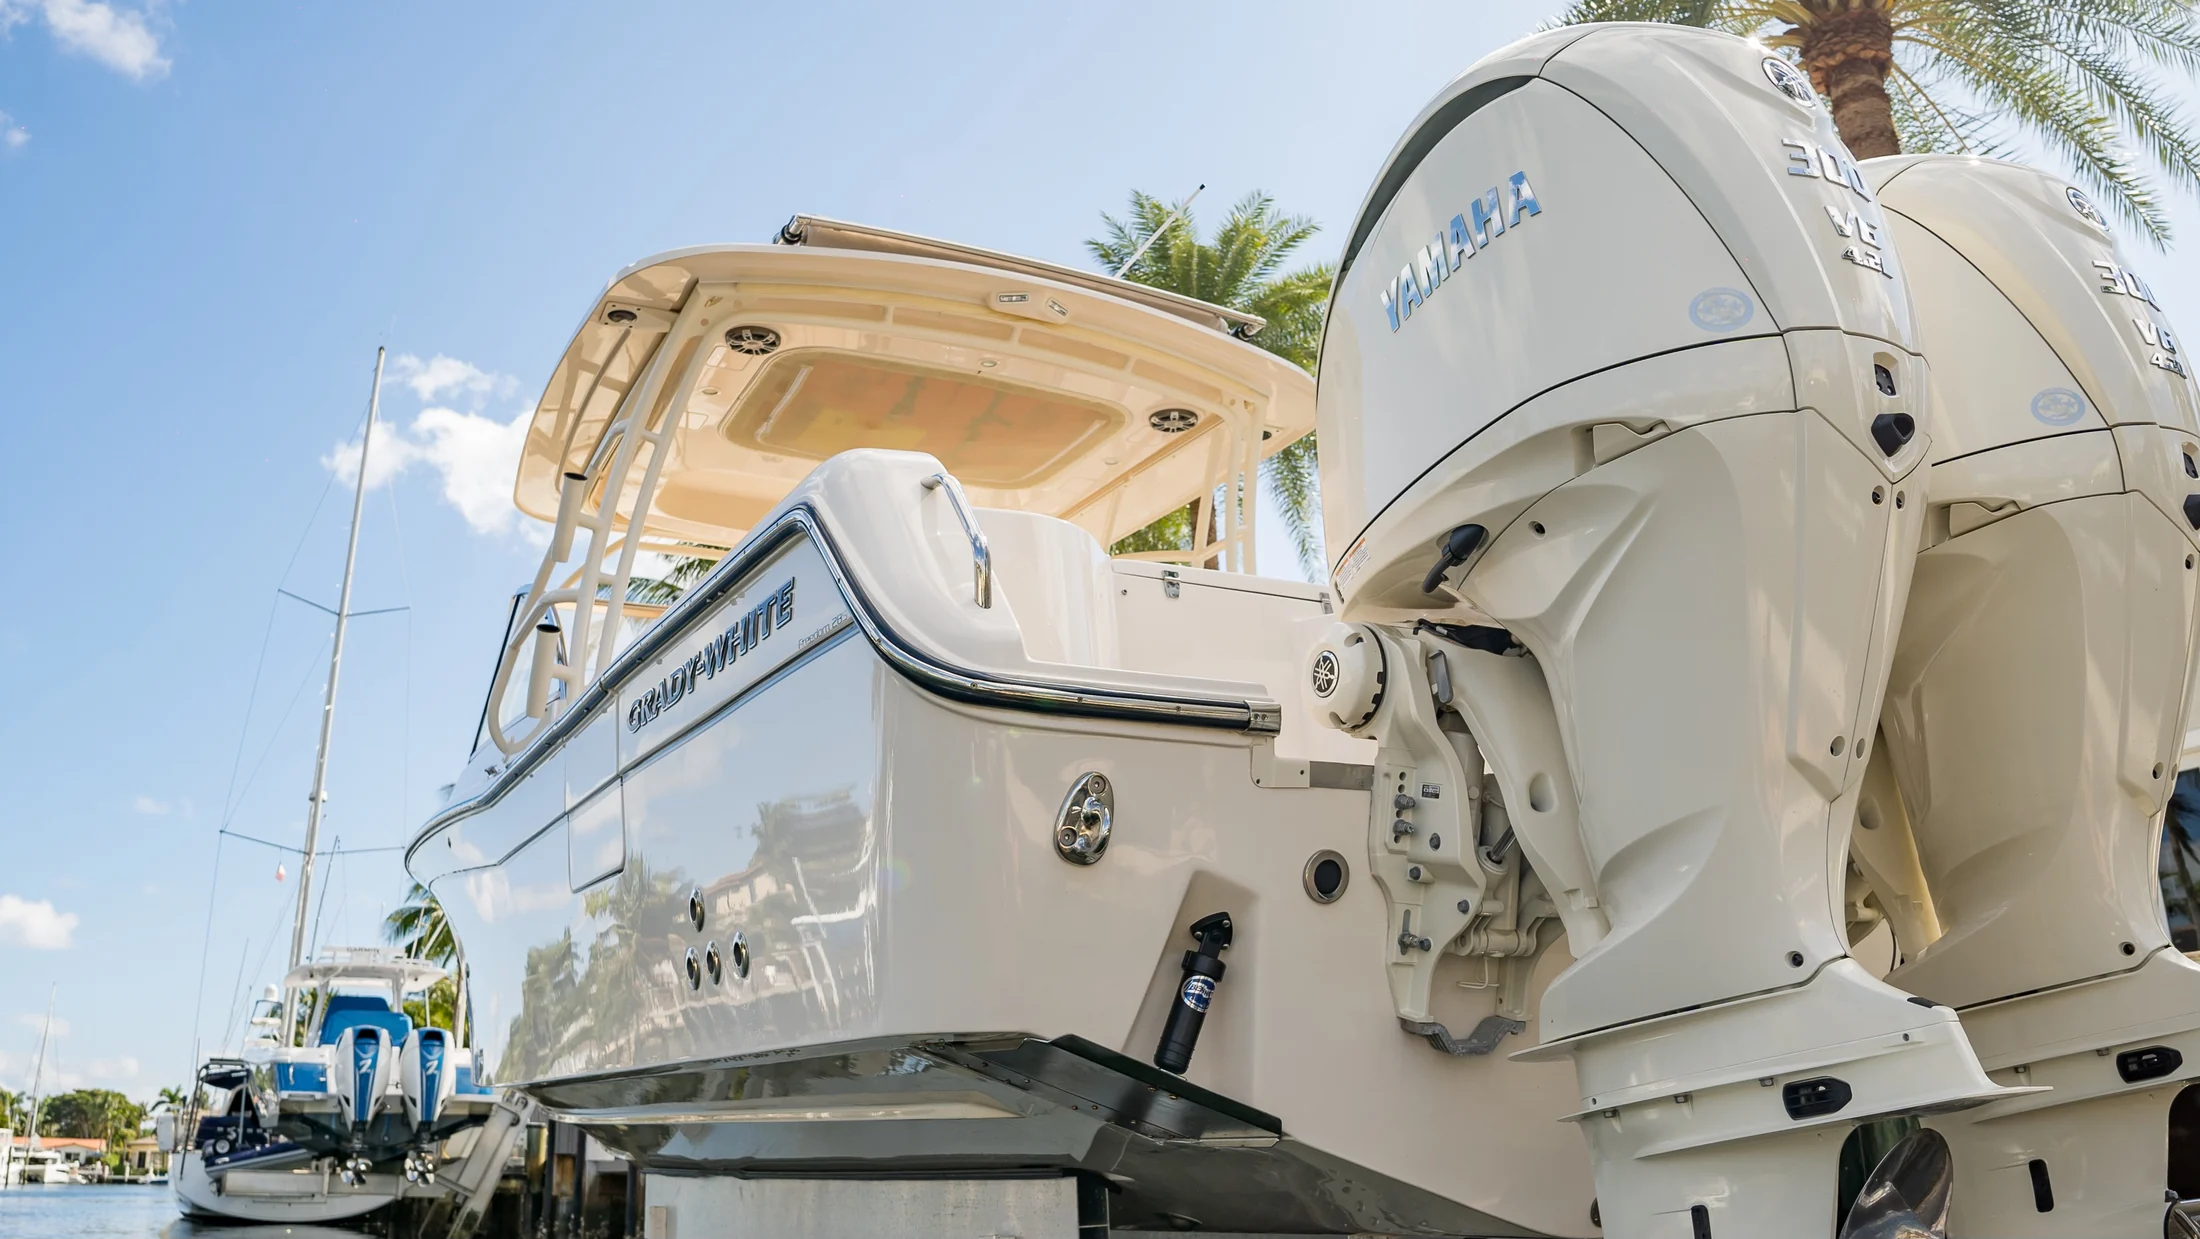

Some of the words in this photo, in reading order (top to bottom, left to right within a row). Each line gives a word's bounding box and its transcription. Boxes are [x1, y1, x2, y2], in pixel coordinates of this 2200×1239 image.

[1781, 138, 1872, 203] 300
[1380, 170, 1542, 333] YAMAHA
[1824, 205, 1882, 251] V6
[2131, 319, 2177, 354] V6
[627, 576, 796, 734] GRADY-WHITE
